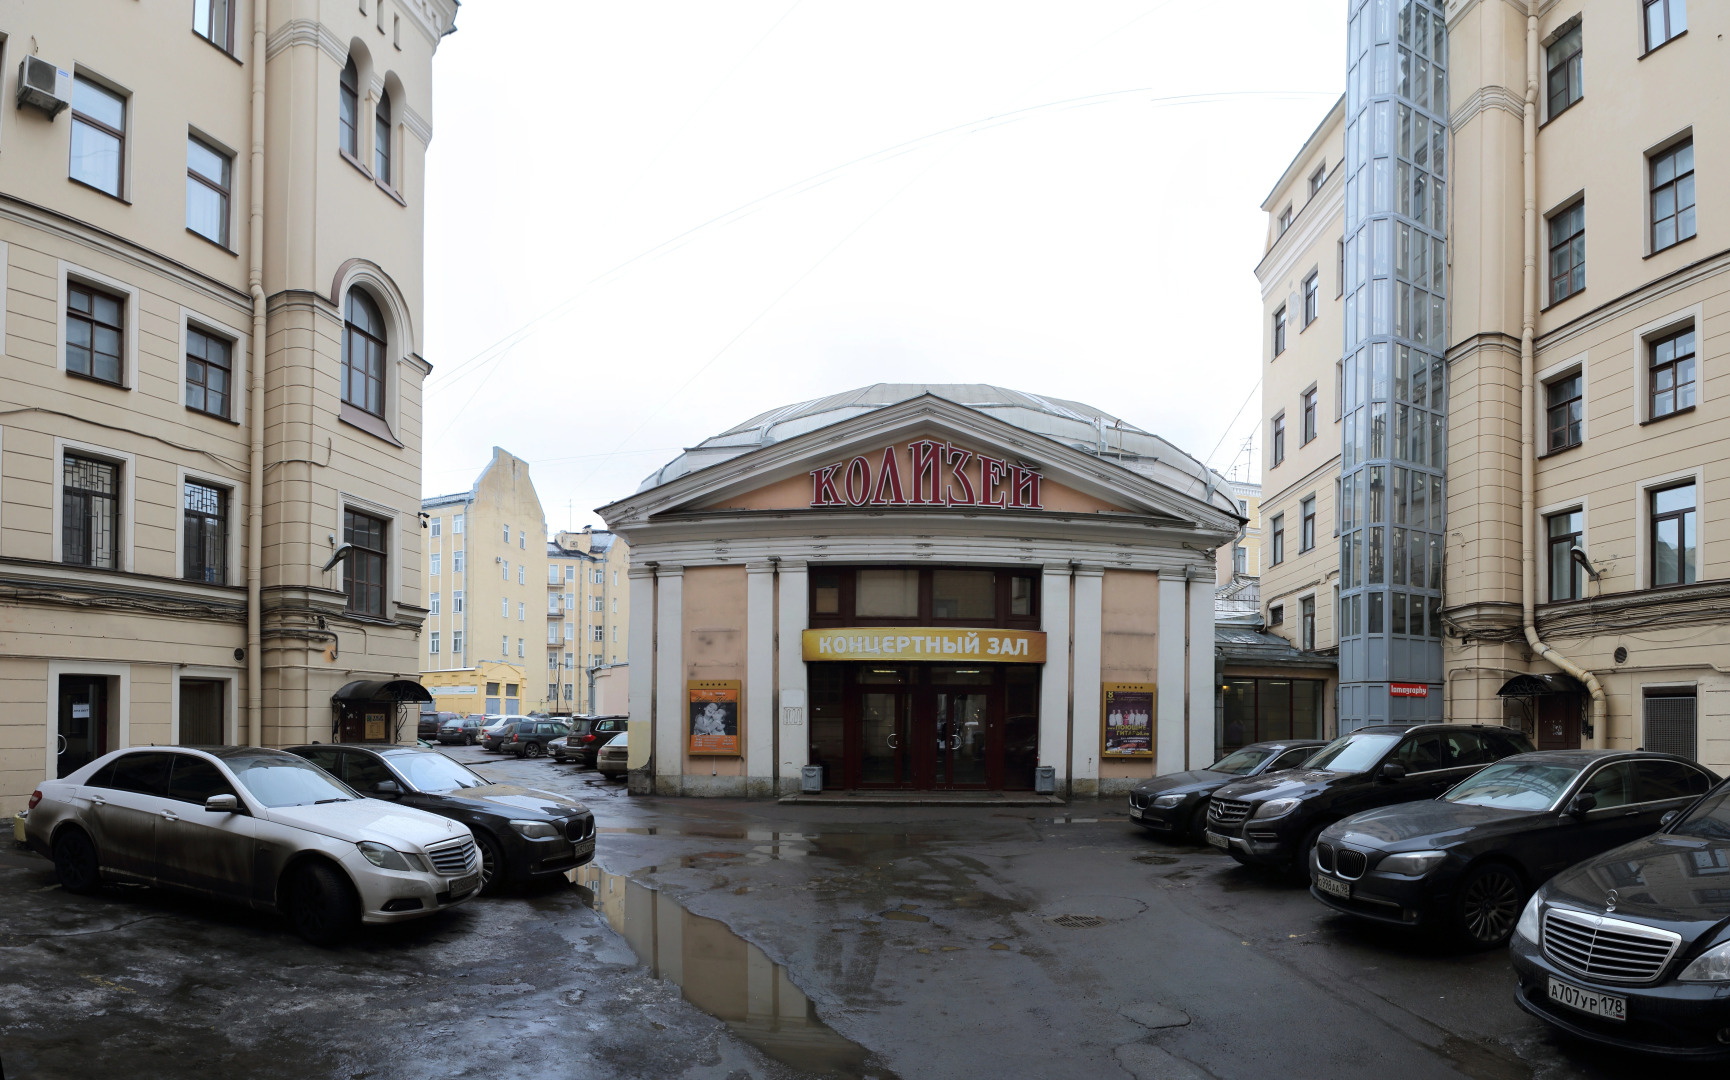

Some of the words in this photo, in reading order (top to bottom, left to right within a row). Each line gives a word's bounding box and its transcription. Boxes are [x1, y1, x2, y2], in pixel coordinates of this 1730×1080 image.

[810, 439, 1044, 510] КОЛИЗЕЙ
[819, 632, 980, 654] КОНЦЕРТНЫЙ
[986, 637, 1028, 656] ЗАЛ
[1600, 996, 1623, 1013] 178
